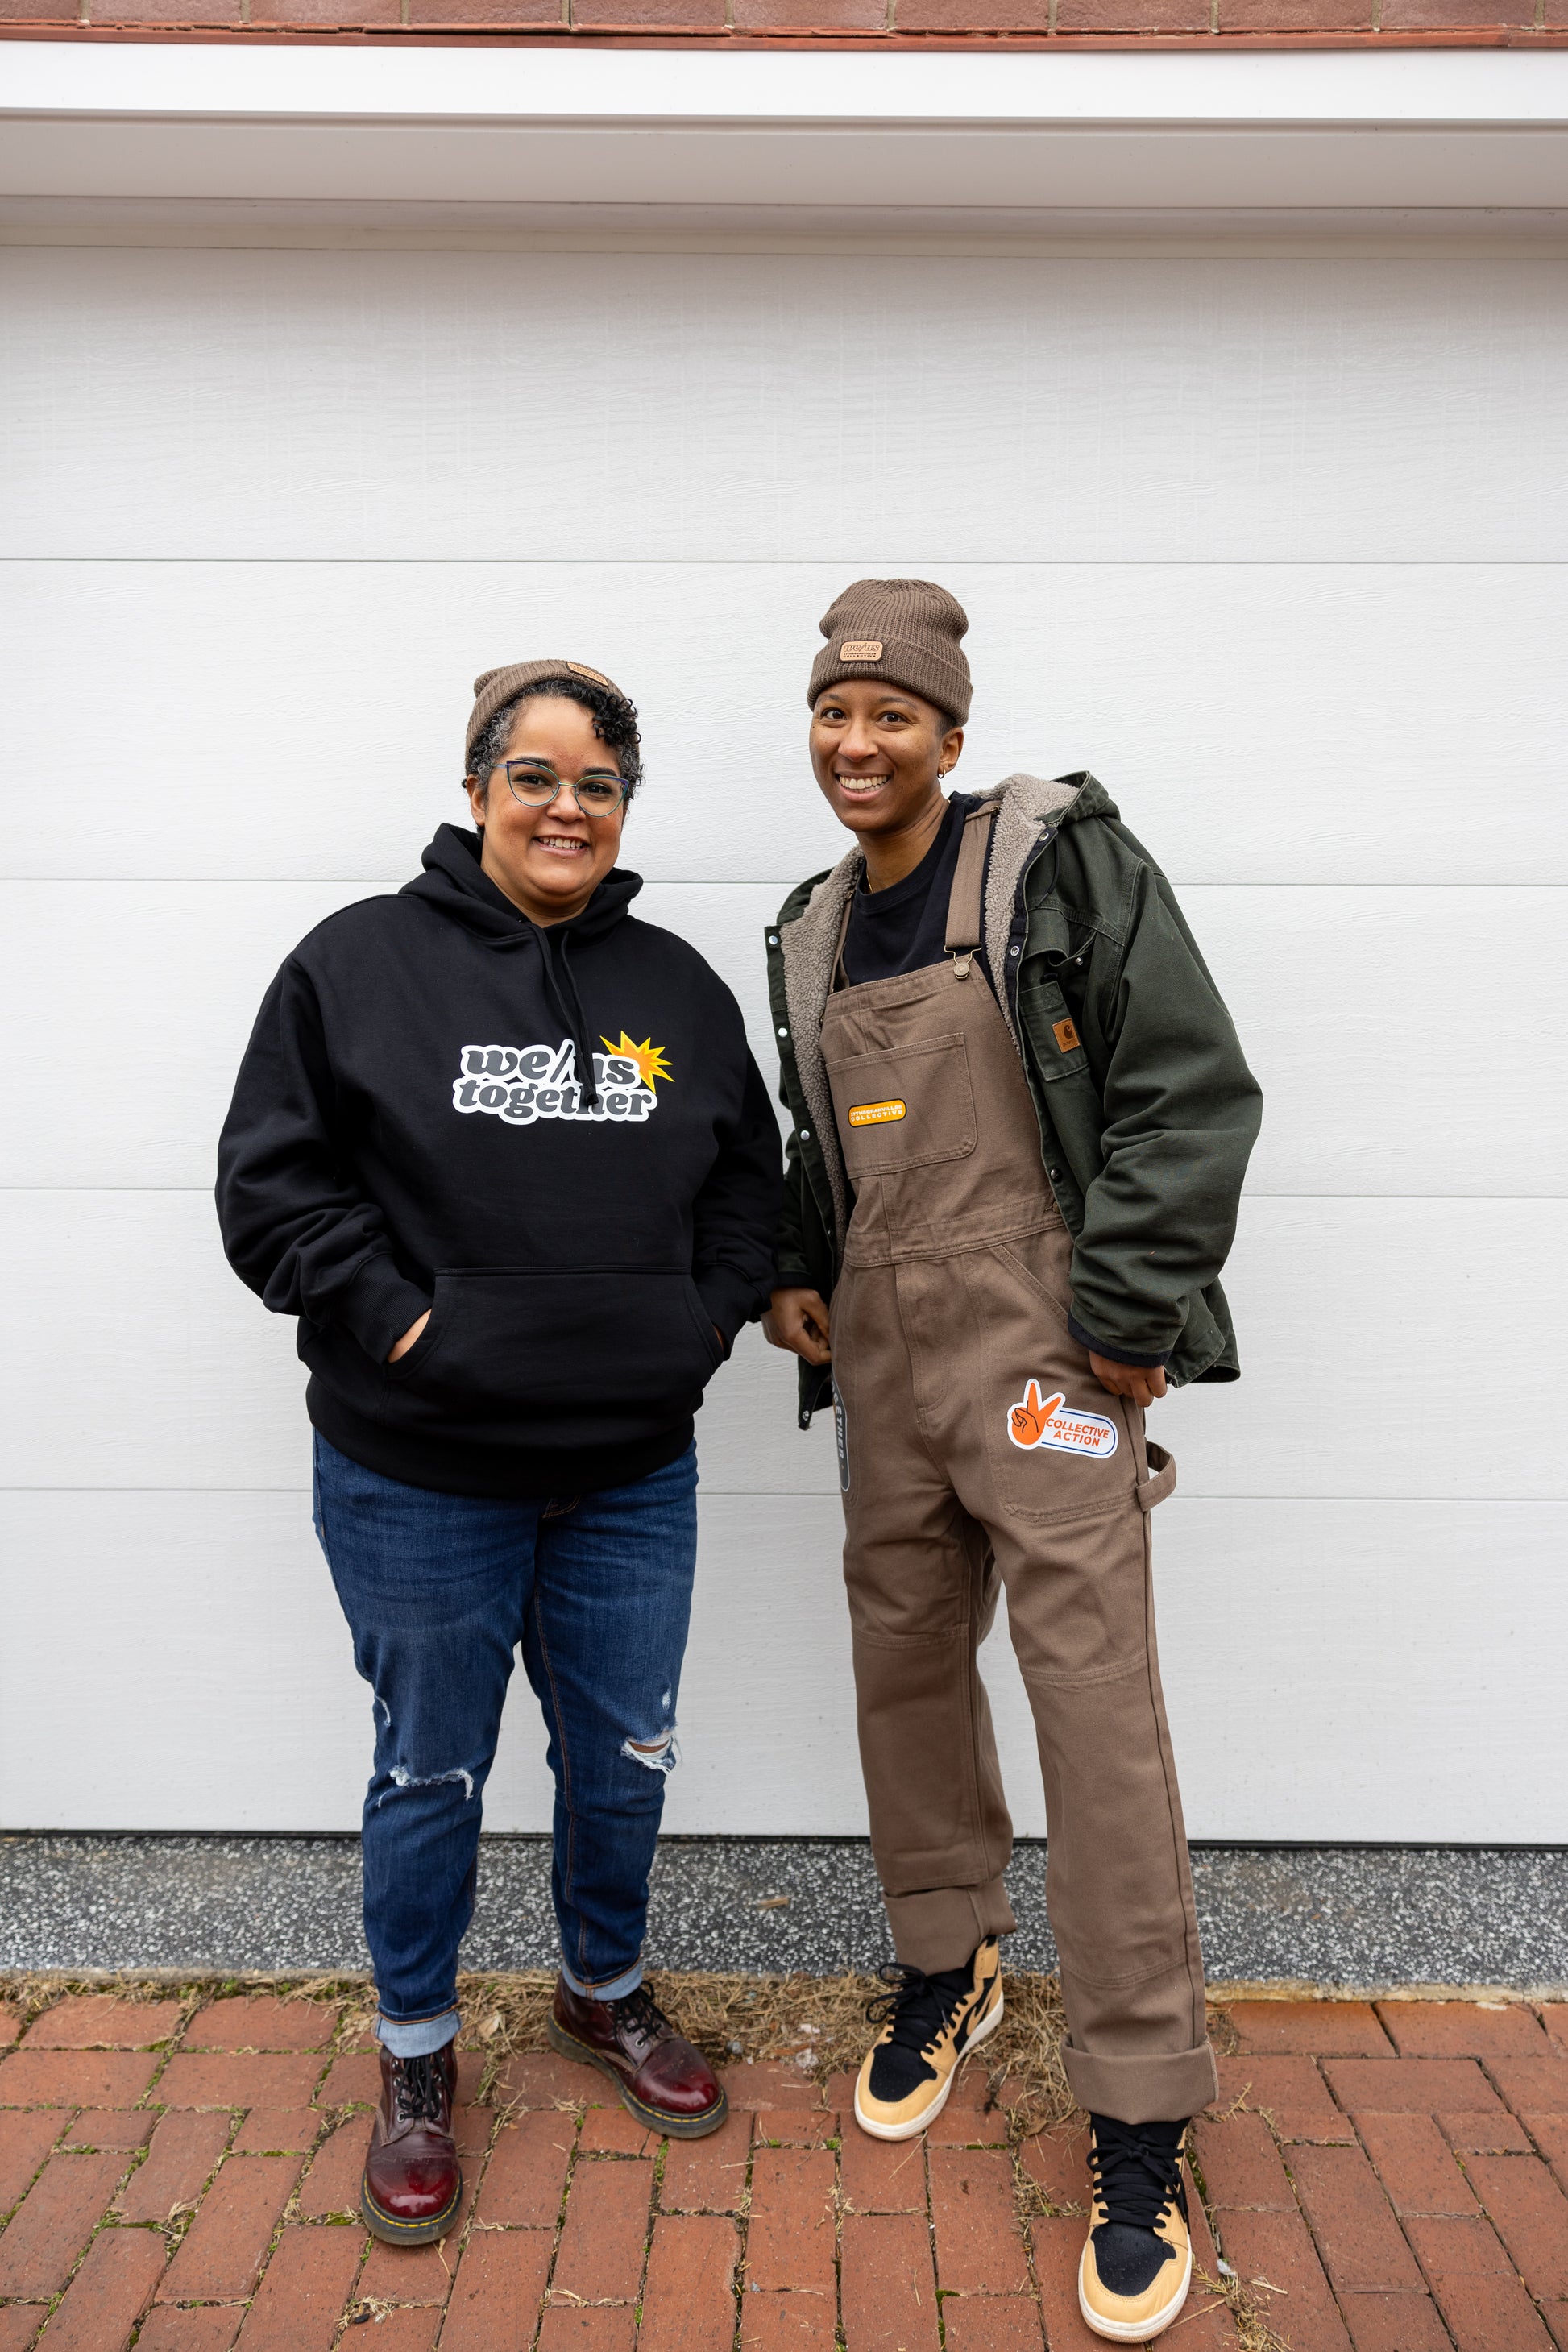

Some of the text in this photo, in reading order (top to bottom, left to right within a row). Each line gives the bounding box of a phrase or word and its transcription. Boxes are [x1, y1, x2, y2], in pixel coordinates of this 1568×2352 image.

[457, 1078, 654, 1121] together
[851, 1110, 903, 1122] COLLECTIVE
[1046, 1418, 1110, 1438] COLLECTIVE
[1052, 1430, 1101, 1447] ACTION
